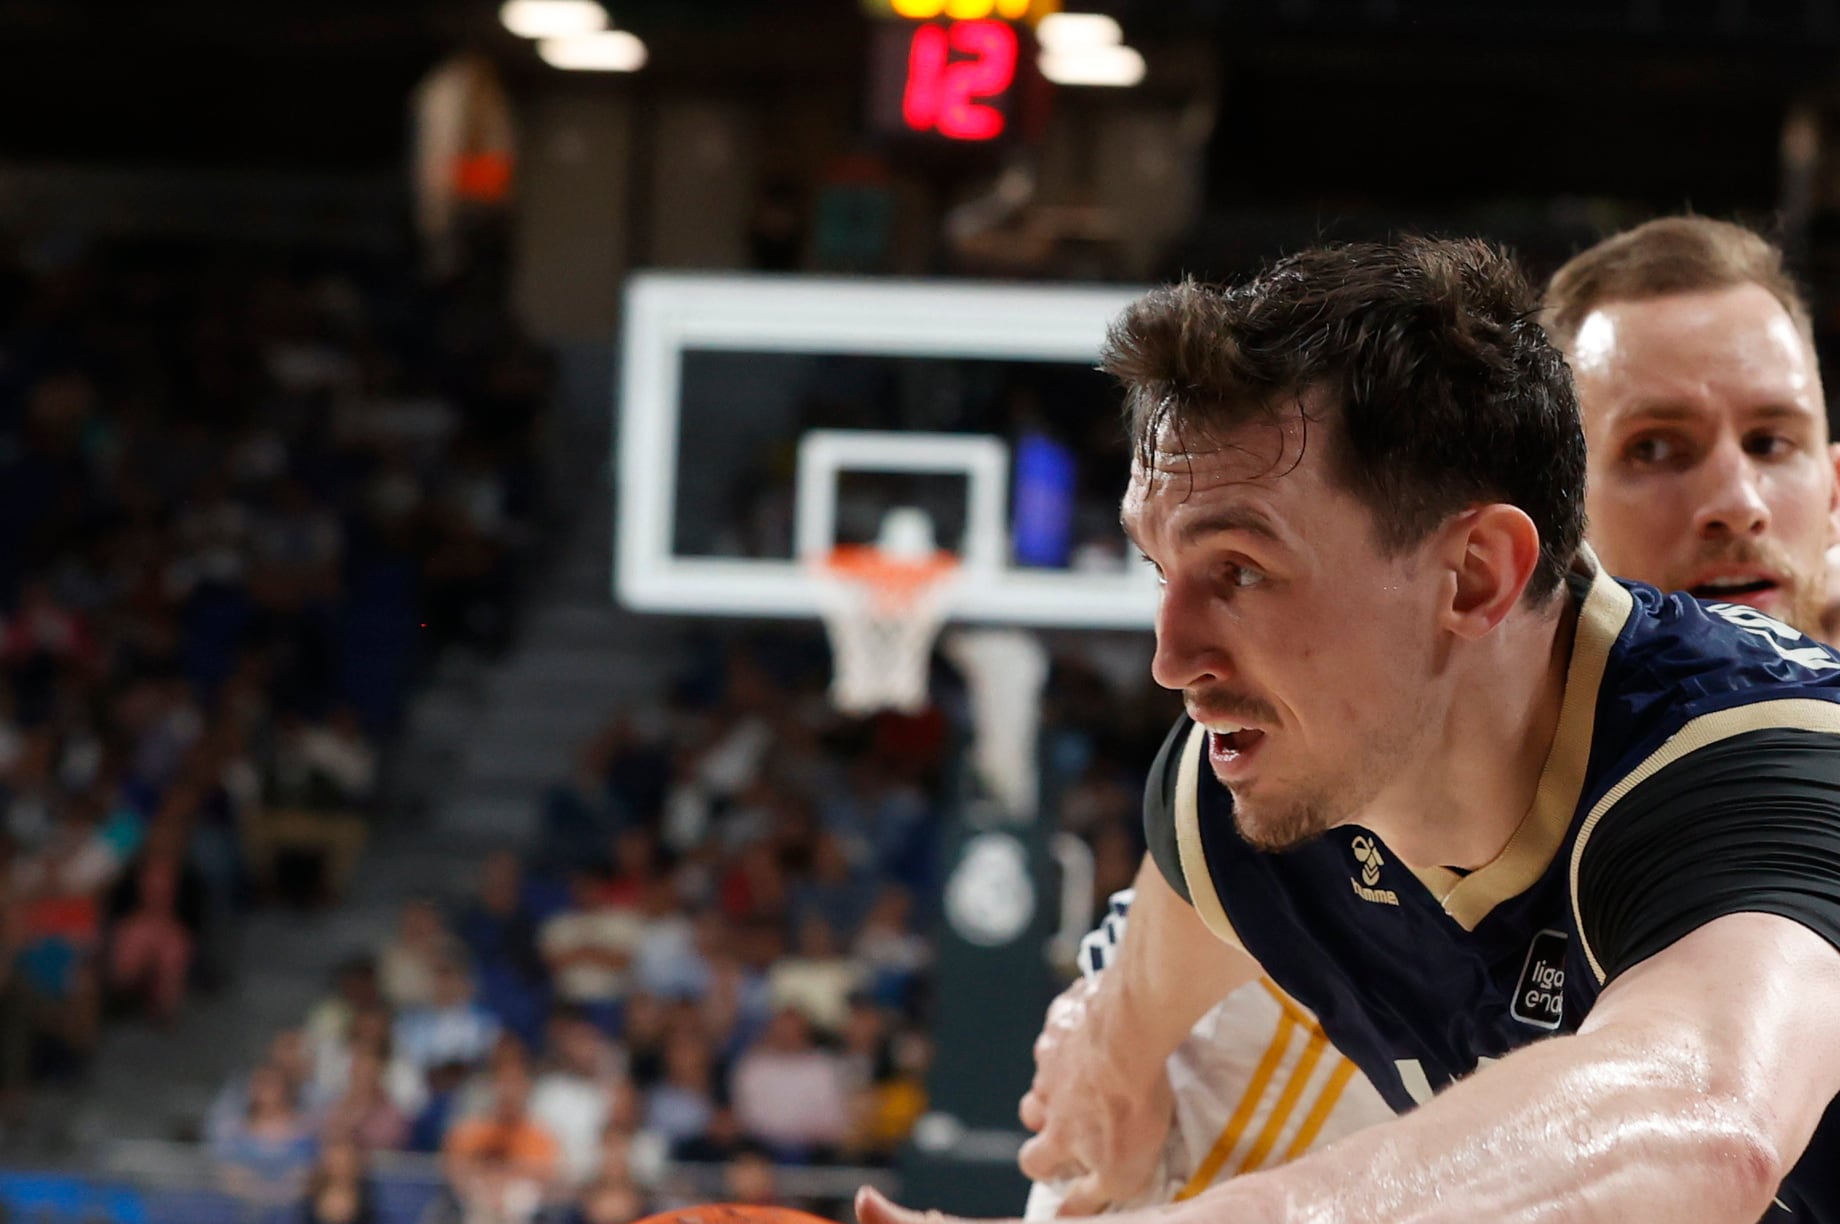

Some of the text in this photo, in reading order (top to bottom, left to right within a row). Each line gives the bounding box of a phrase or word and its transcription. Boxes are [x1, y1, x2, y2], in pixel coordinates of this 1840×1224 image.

[903, 18, 1018, 140] 12
[1350, 876, 1400, 907] humme
[1531, 959, 1565, 989] liga
[1524, 990, 1564, 1014] end
